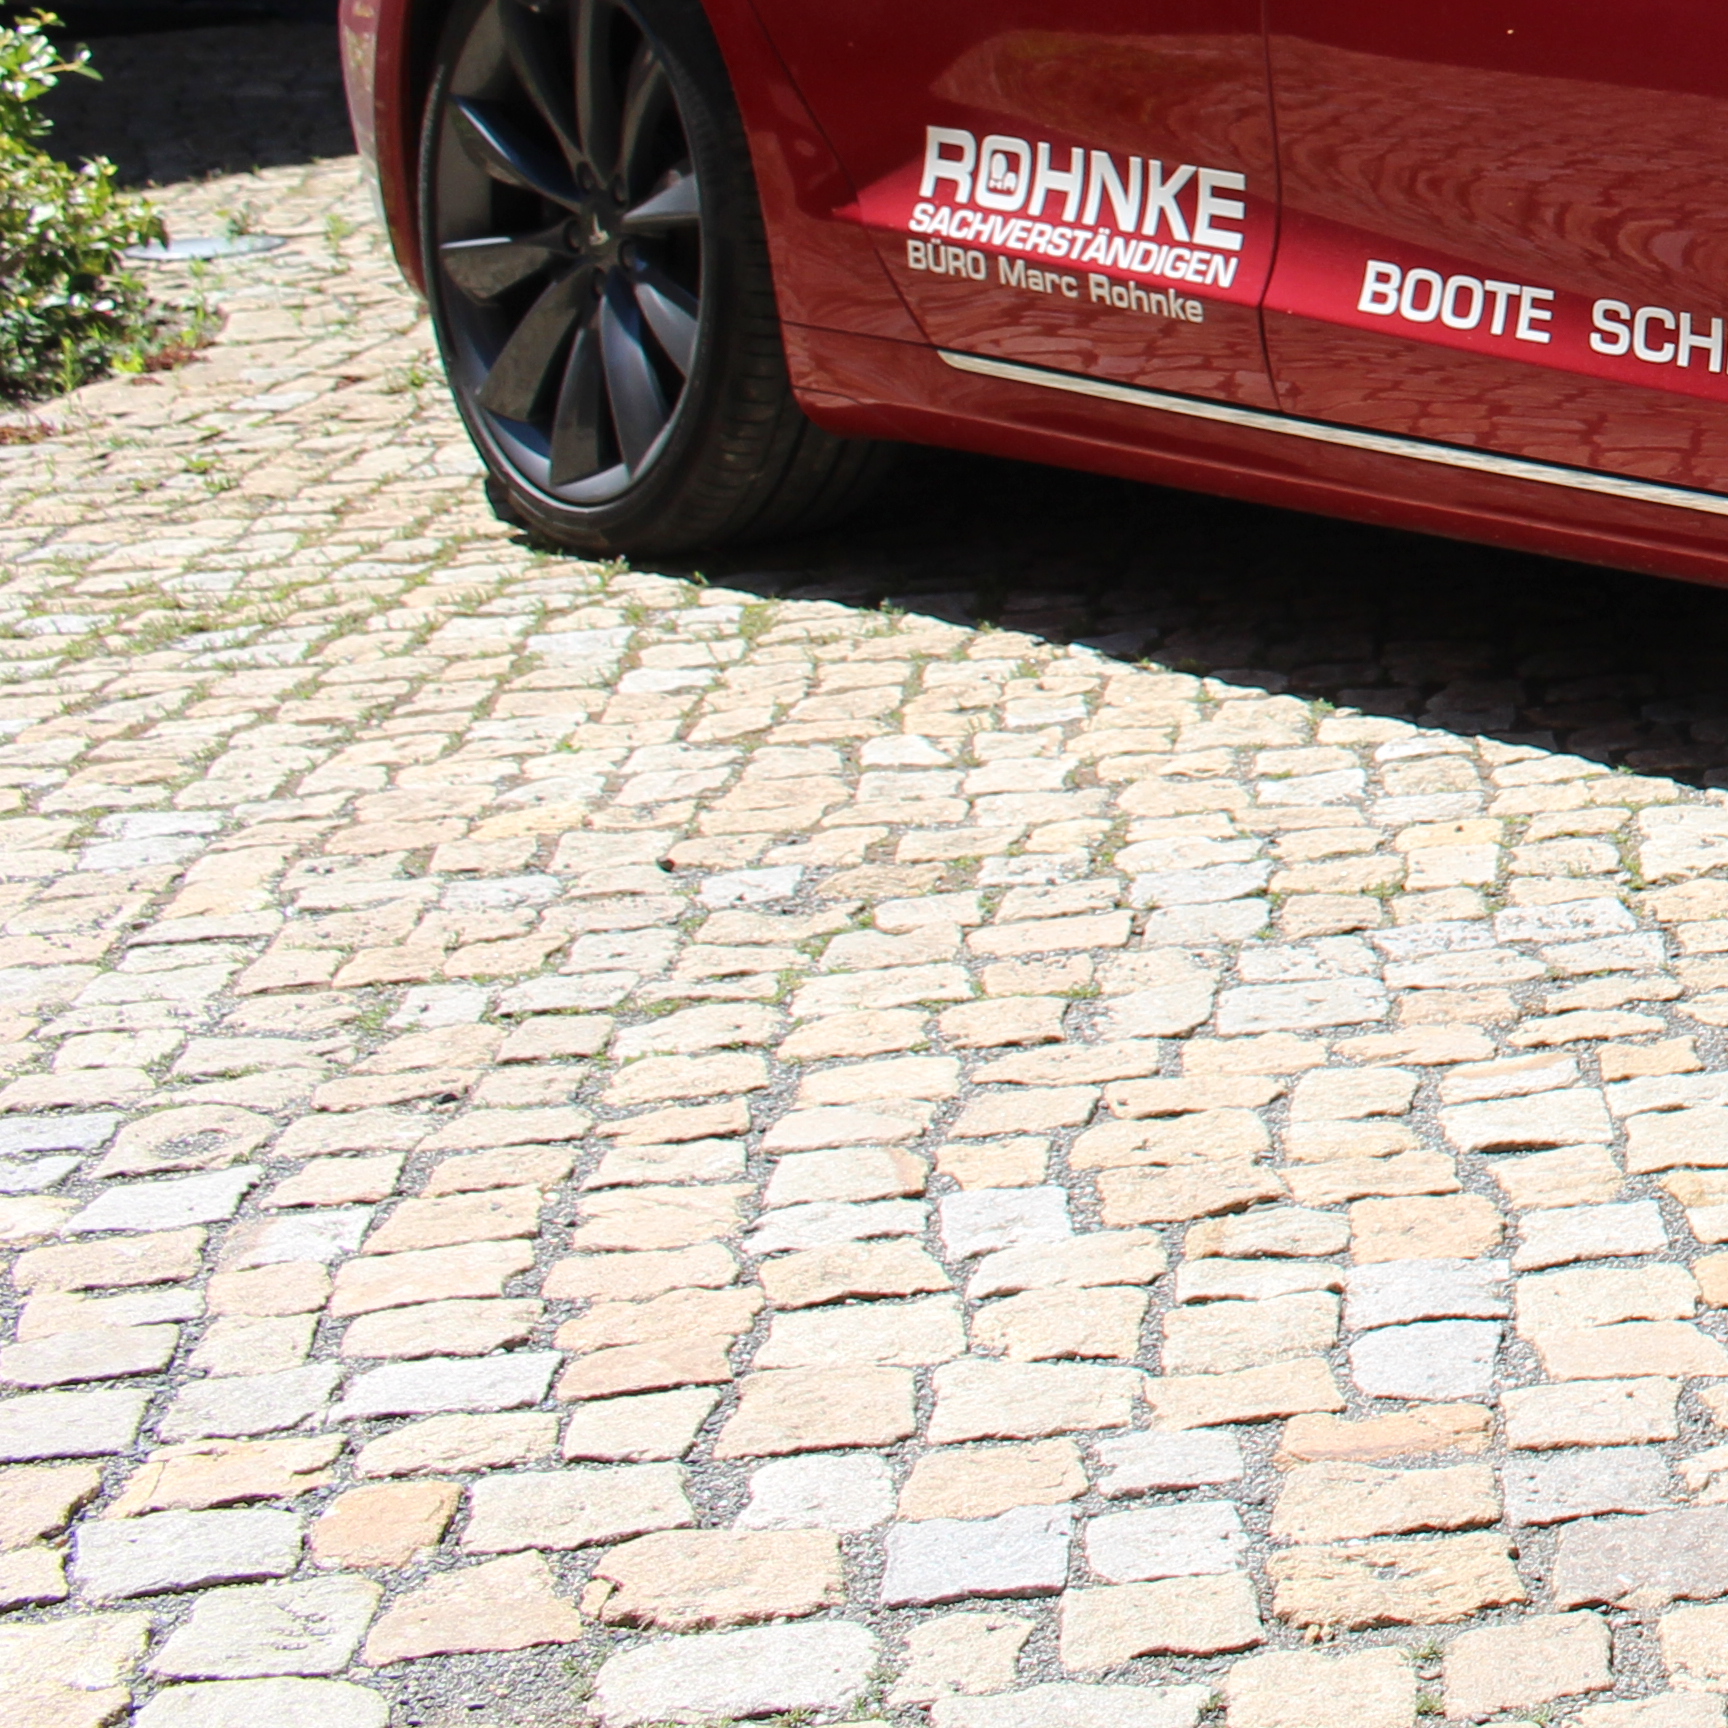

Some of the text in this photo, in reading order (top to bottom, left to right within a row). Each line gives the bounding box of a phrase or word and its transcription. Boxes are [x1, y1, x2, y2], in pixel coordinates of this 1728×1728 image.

[919, 125, 1246, 252] ROHNKE
[906, 238, 1205, 324] BÜRO Marc Rohnke
[908, 202, 1239, 288] SACHVERSTÄNDIGEN
[1357, 259, 1555, 345] BOOTE
